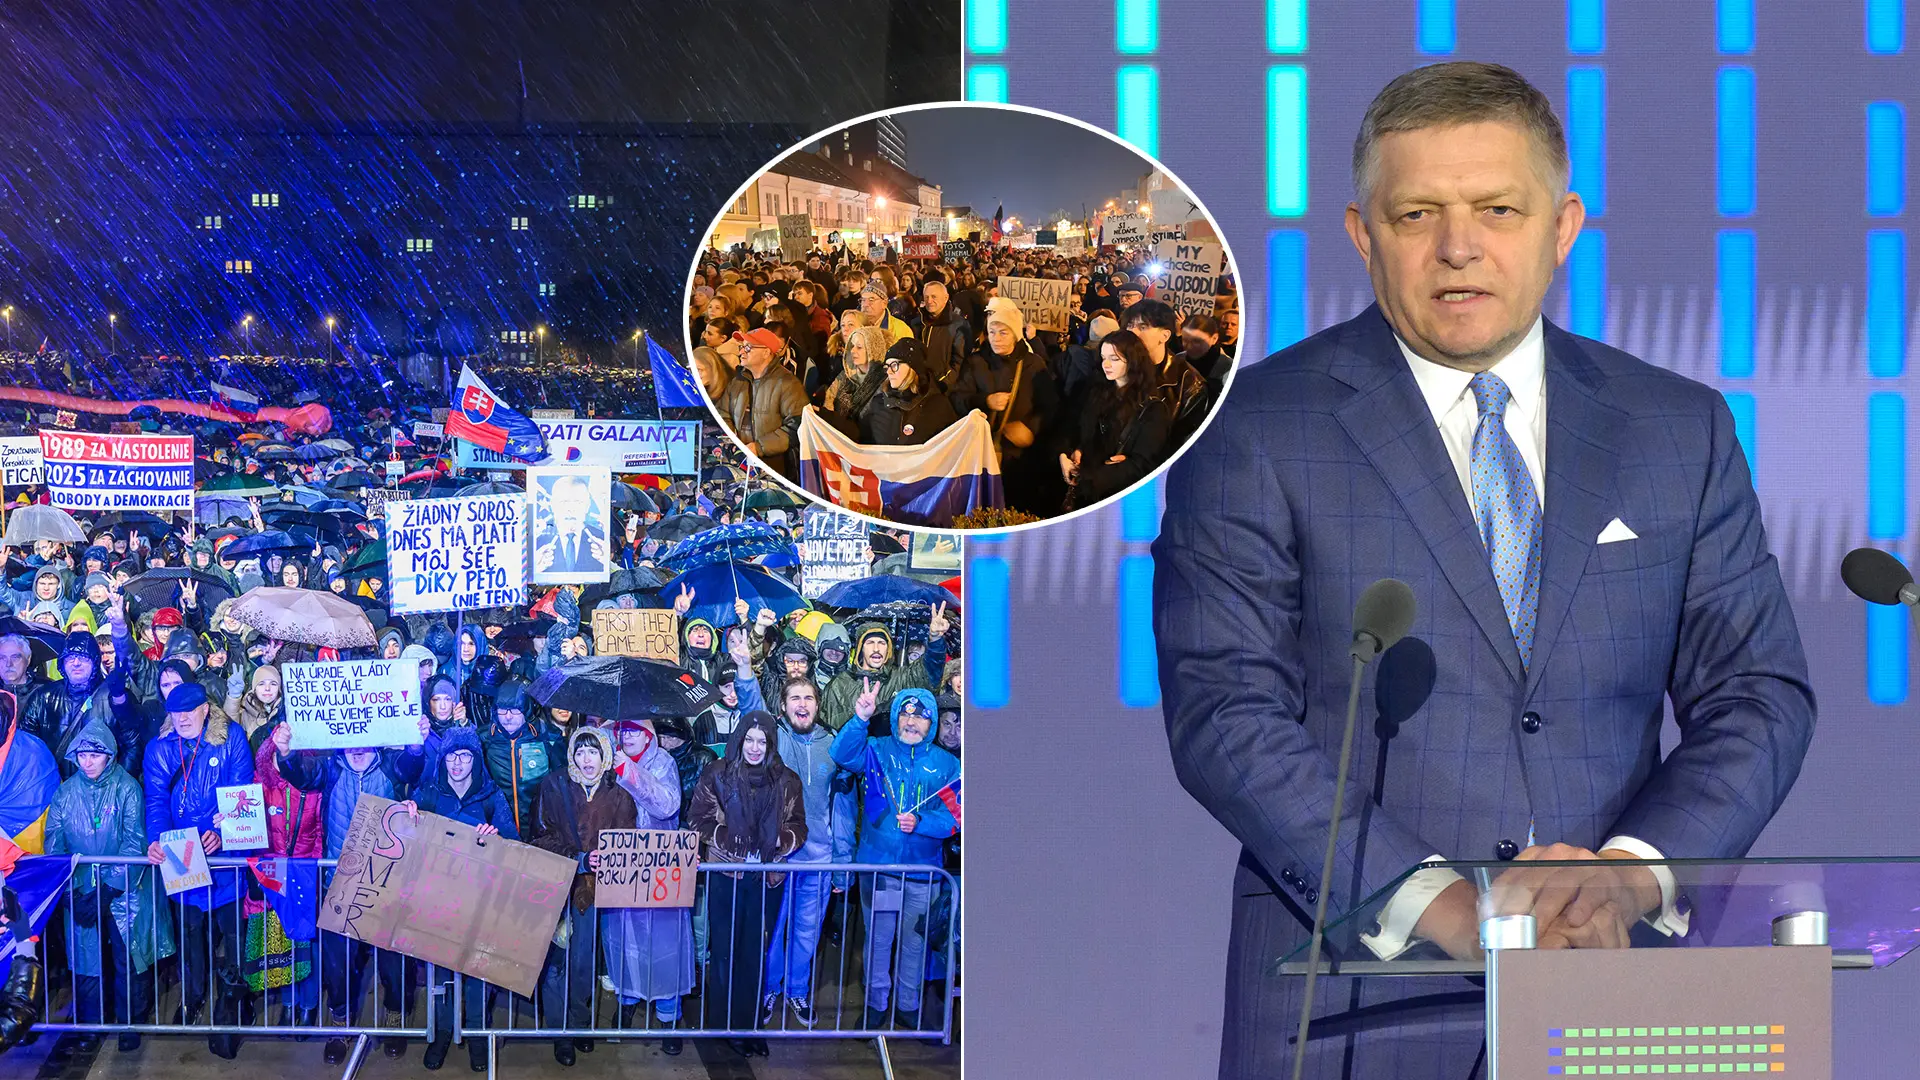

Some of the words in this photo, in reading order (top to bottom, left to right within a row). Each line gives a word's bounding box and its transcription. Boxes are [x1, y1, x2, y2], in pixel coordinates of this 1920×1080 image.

[1176, 245, 1203, 260] MY
[1164, 257, 1211, 273] chceme
[1001, 279, 1069, 307] NEUTEKAM
[1157, 273, 1218, 297] SLOBODU
[1162, 293, 1171, 302] a
[1173, 292, 1214, 309] hlavne
[537, 424, 583, 440] RATI
[588, 424, 688, 443] GALANTA
[42, 436, 86, 459] 1989
[90, 442, 107, 458] ZA
[111, 442, 190, 460] NASTOLENIE
[6, 467, 43, 484] FICA!
[45, 463, 86, 486] 2025
[89, 469, 105, 485] ZA
[108, 469, 191, 487] ZACHOVANIE
[51, 491, 100, 507] LOBODY
[114, 494, 190, 507] DEMOKRACIE
[402, 502, 462, 528] ŽIADNY
[467, 499, 519, 522] SOROS.
[393, 527, 432, 551] DNES
[441, 525, 468, 548] MA
[473, 520, 518, 546] PLATÍ
[809, 512, 830, 538] 17.
[412, 548, 450, 572] MÔJ
[461, 545, 497, 570] ŠÉF.
[804, 539, 870, 563] NOVEMBER
[415, 570, 458, 595] DÍKY
[466, 566, 509, 591] PEŤO.
[452, 593, 480, 608] (NIE
[485, 588, 521, 605] TEN)
[595, 612, 634, 632] FIRST
[638, 612, 674, 633] THEY
[595, 635, 640, 653] CAME
[645, 634, 677, 655] FOR
[289, 667, 305, 680] NA
[309, 663, 345, 679] ÚRADE
[351, 660, 392, 678] VLÁDY
[286, 680, 319, 693] EŠTE
[323, 678, 363, 693] STÁLE
[684, 683, 709, 704] PARIS
[290, 692, 355, 707] OSLAVUJÚ
[360, 691, 394, 705] VOSR
[294, 709, 312, 722] MY
[315, 708, 337, 721] ALE
[340, 706, 374, 720] VIEME
[378, 704, 400, 718] KDE
[403, 703, 419, 716] JE
[599, 830, 650, 850] STOJÍM
[655, 833, 672, 849] TU
[673, 832, 697, 850] AKO
[599, 852, 627, 868] MOJI
[630, 849, 680, 868] RODIČIA
[685, 853, 695, 867] V
[597, 869, 627, 885] ROKU
[629, 867, 682, 902] 1989
